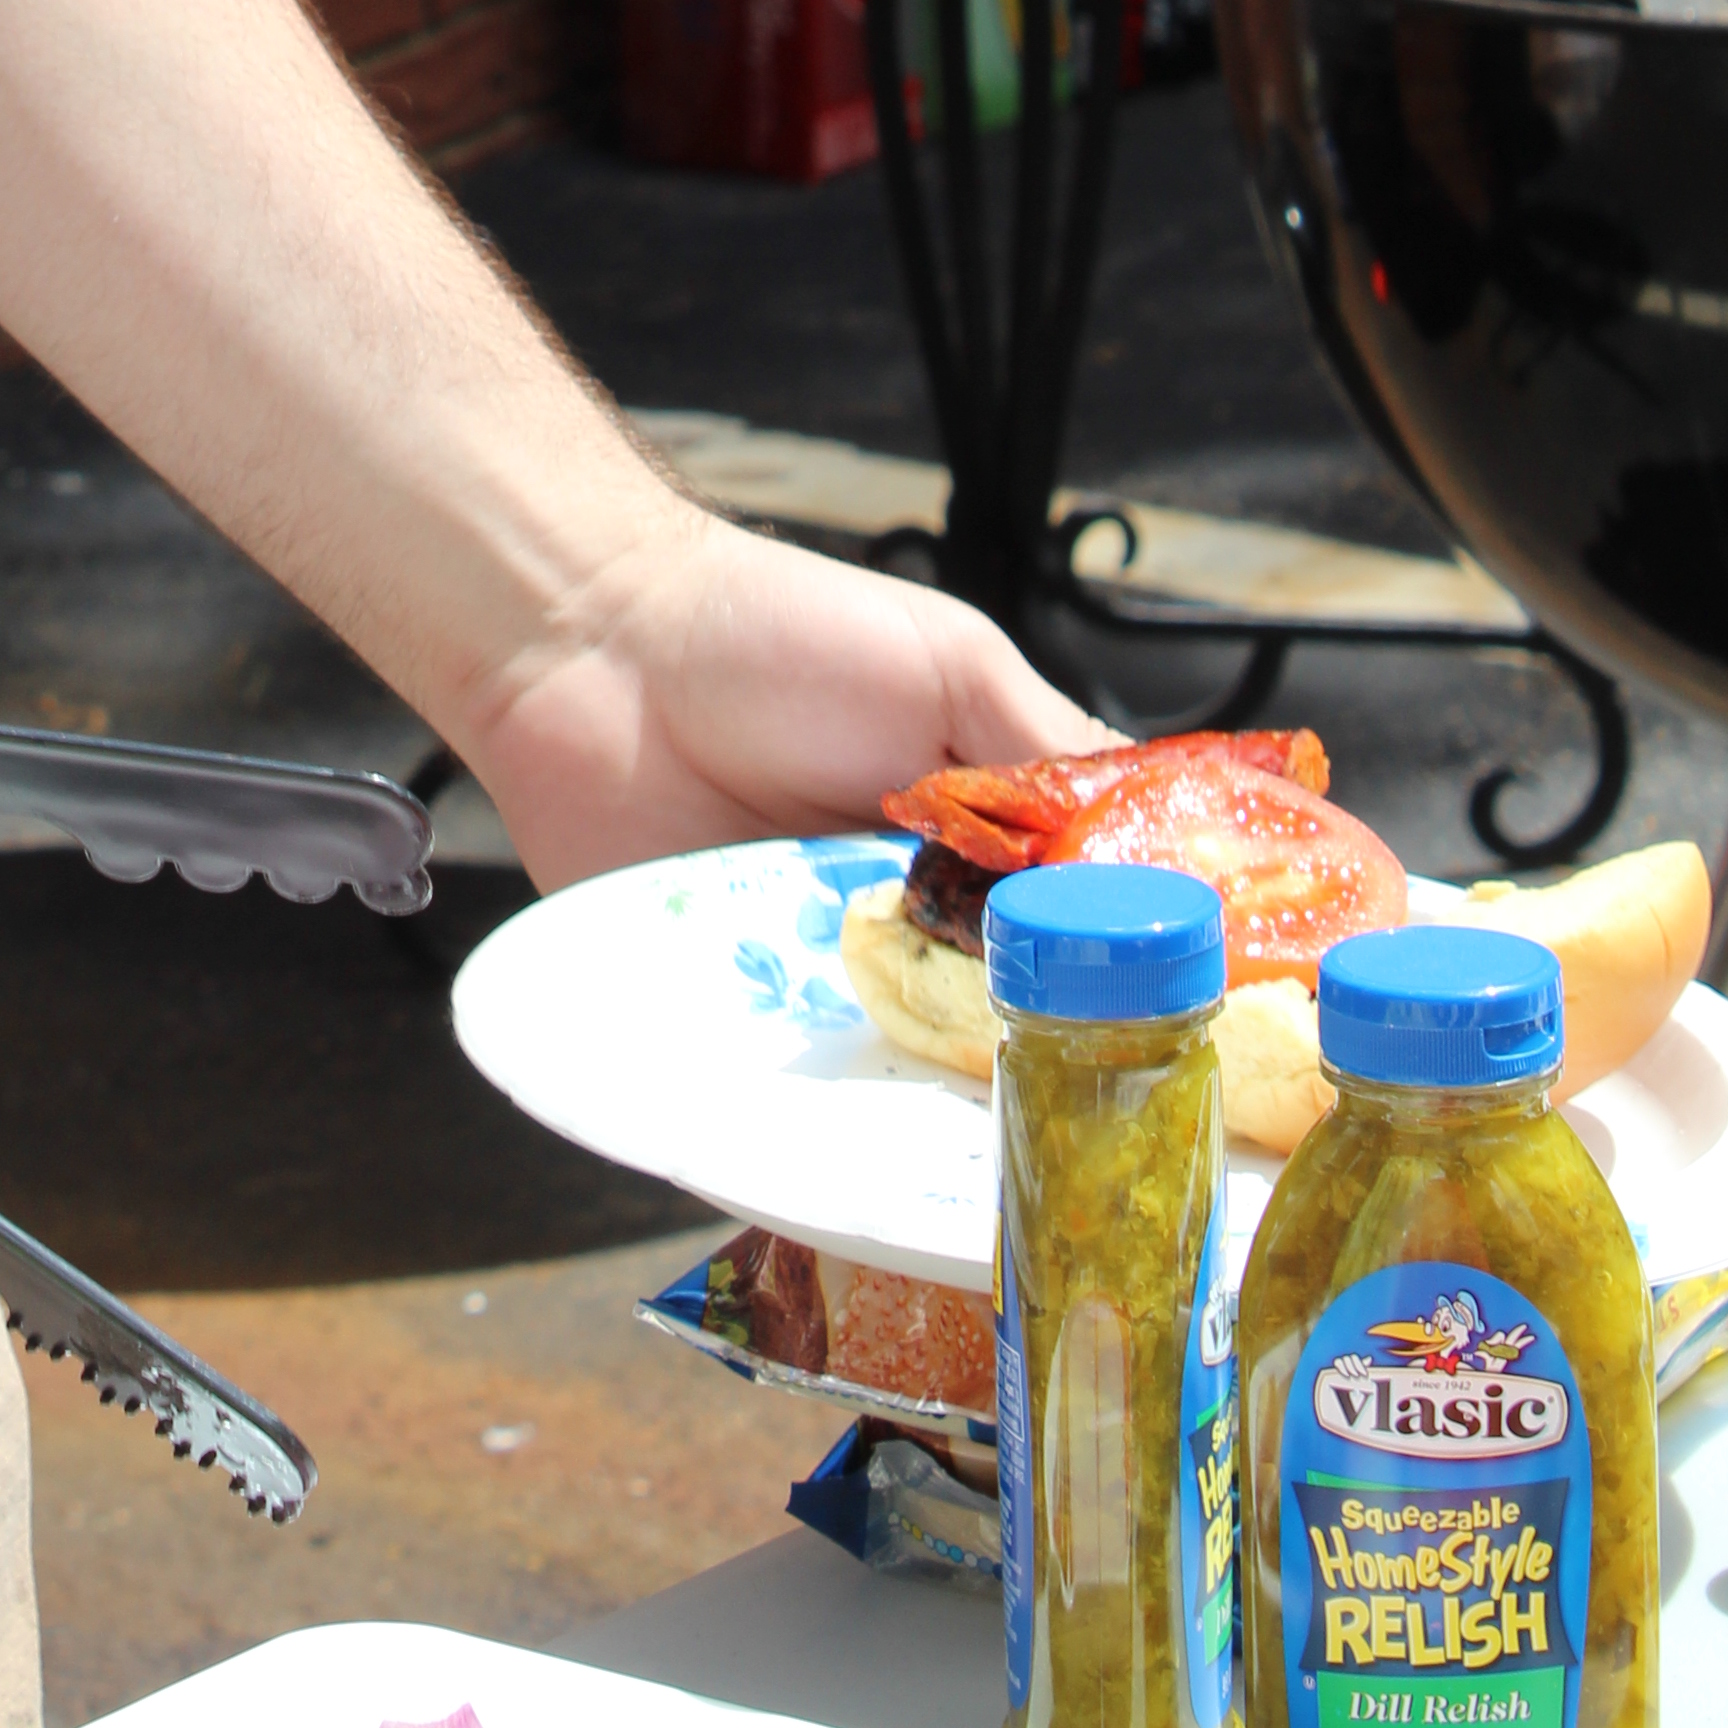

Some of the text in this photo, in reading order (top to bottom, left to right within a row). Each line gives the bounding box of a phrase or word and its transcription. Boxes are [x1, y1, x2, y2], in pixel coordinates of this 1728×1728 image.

[1412, 1378, 1472, 1392] since 1942
[1340, 1496, 1521, 1536] Squeezable
[1308, 1525, 1554, 1601] HomeStyle
[1324, 1591, 1550, 1669] RELISH
[1348, 1690, 1532, 1725] Dill Relish
